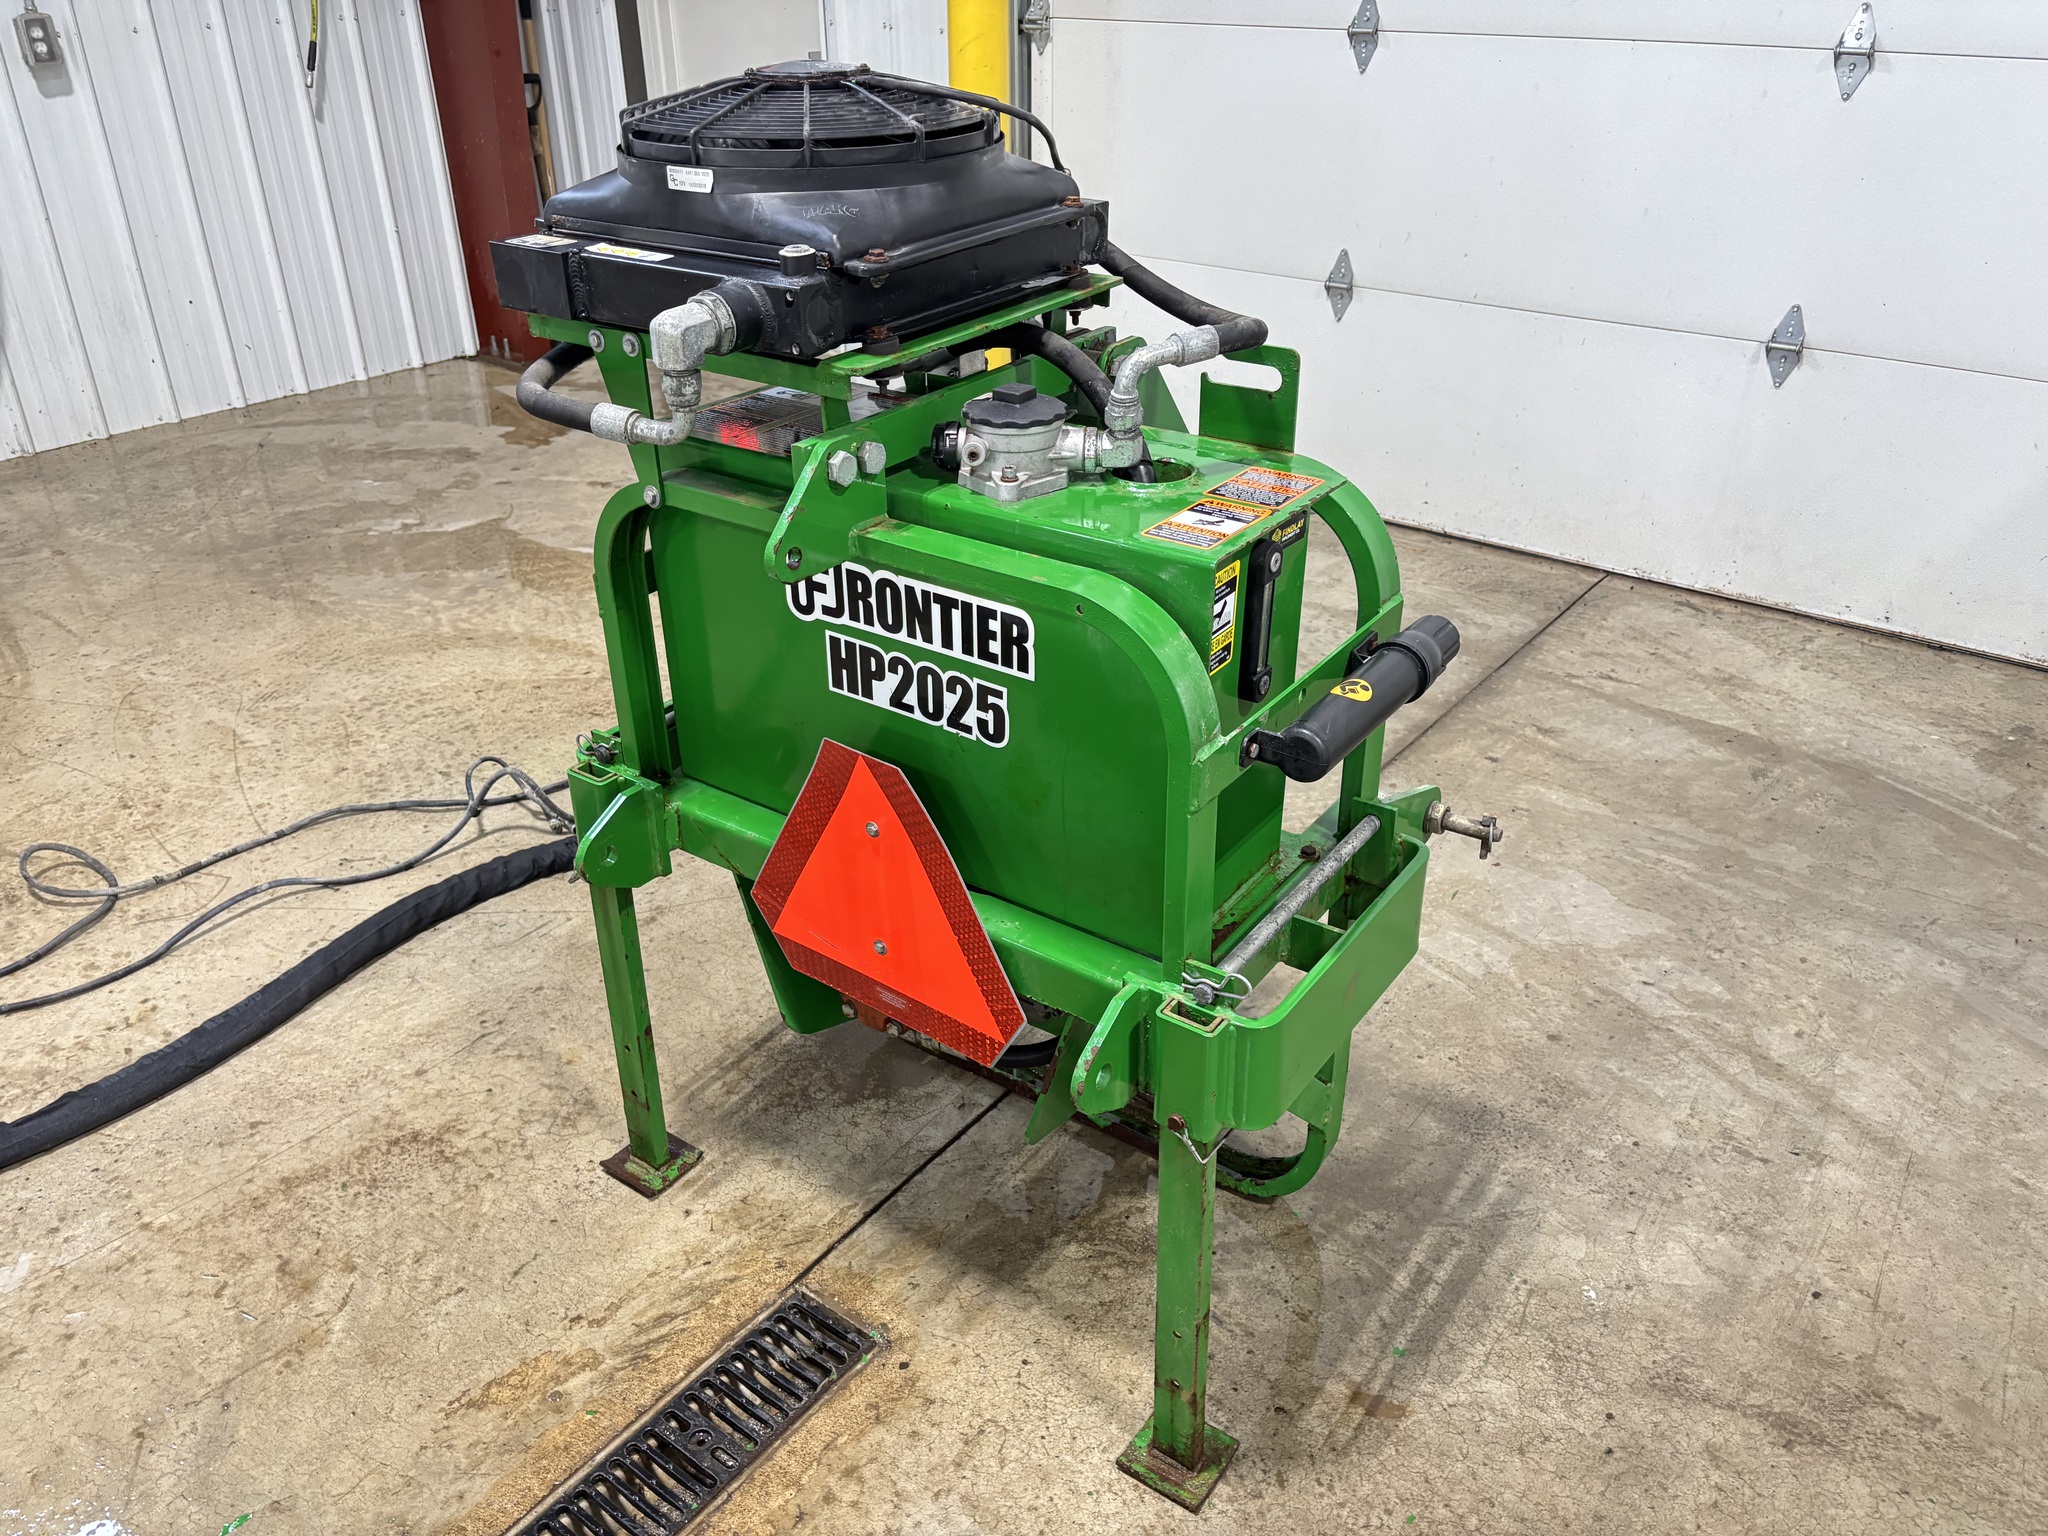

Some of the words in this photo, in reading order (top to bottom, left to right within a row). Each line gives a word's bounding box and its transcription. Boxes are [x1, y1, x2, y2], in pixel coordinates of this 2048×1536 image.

[1263, 469, 1323, 483] WARNING
[1242, 480, 1303, 495] ATTENTION
[1215, 500, 1267, 515] WARNING
[1173, 521, 1229, 538] ATTENTION
[1282, 518, 1305, 537] FINDLAY
[829, 635, 1006, 743] HP2025
